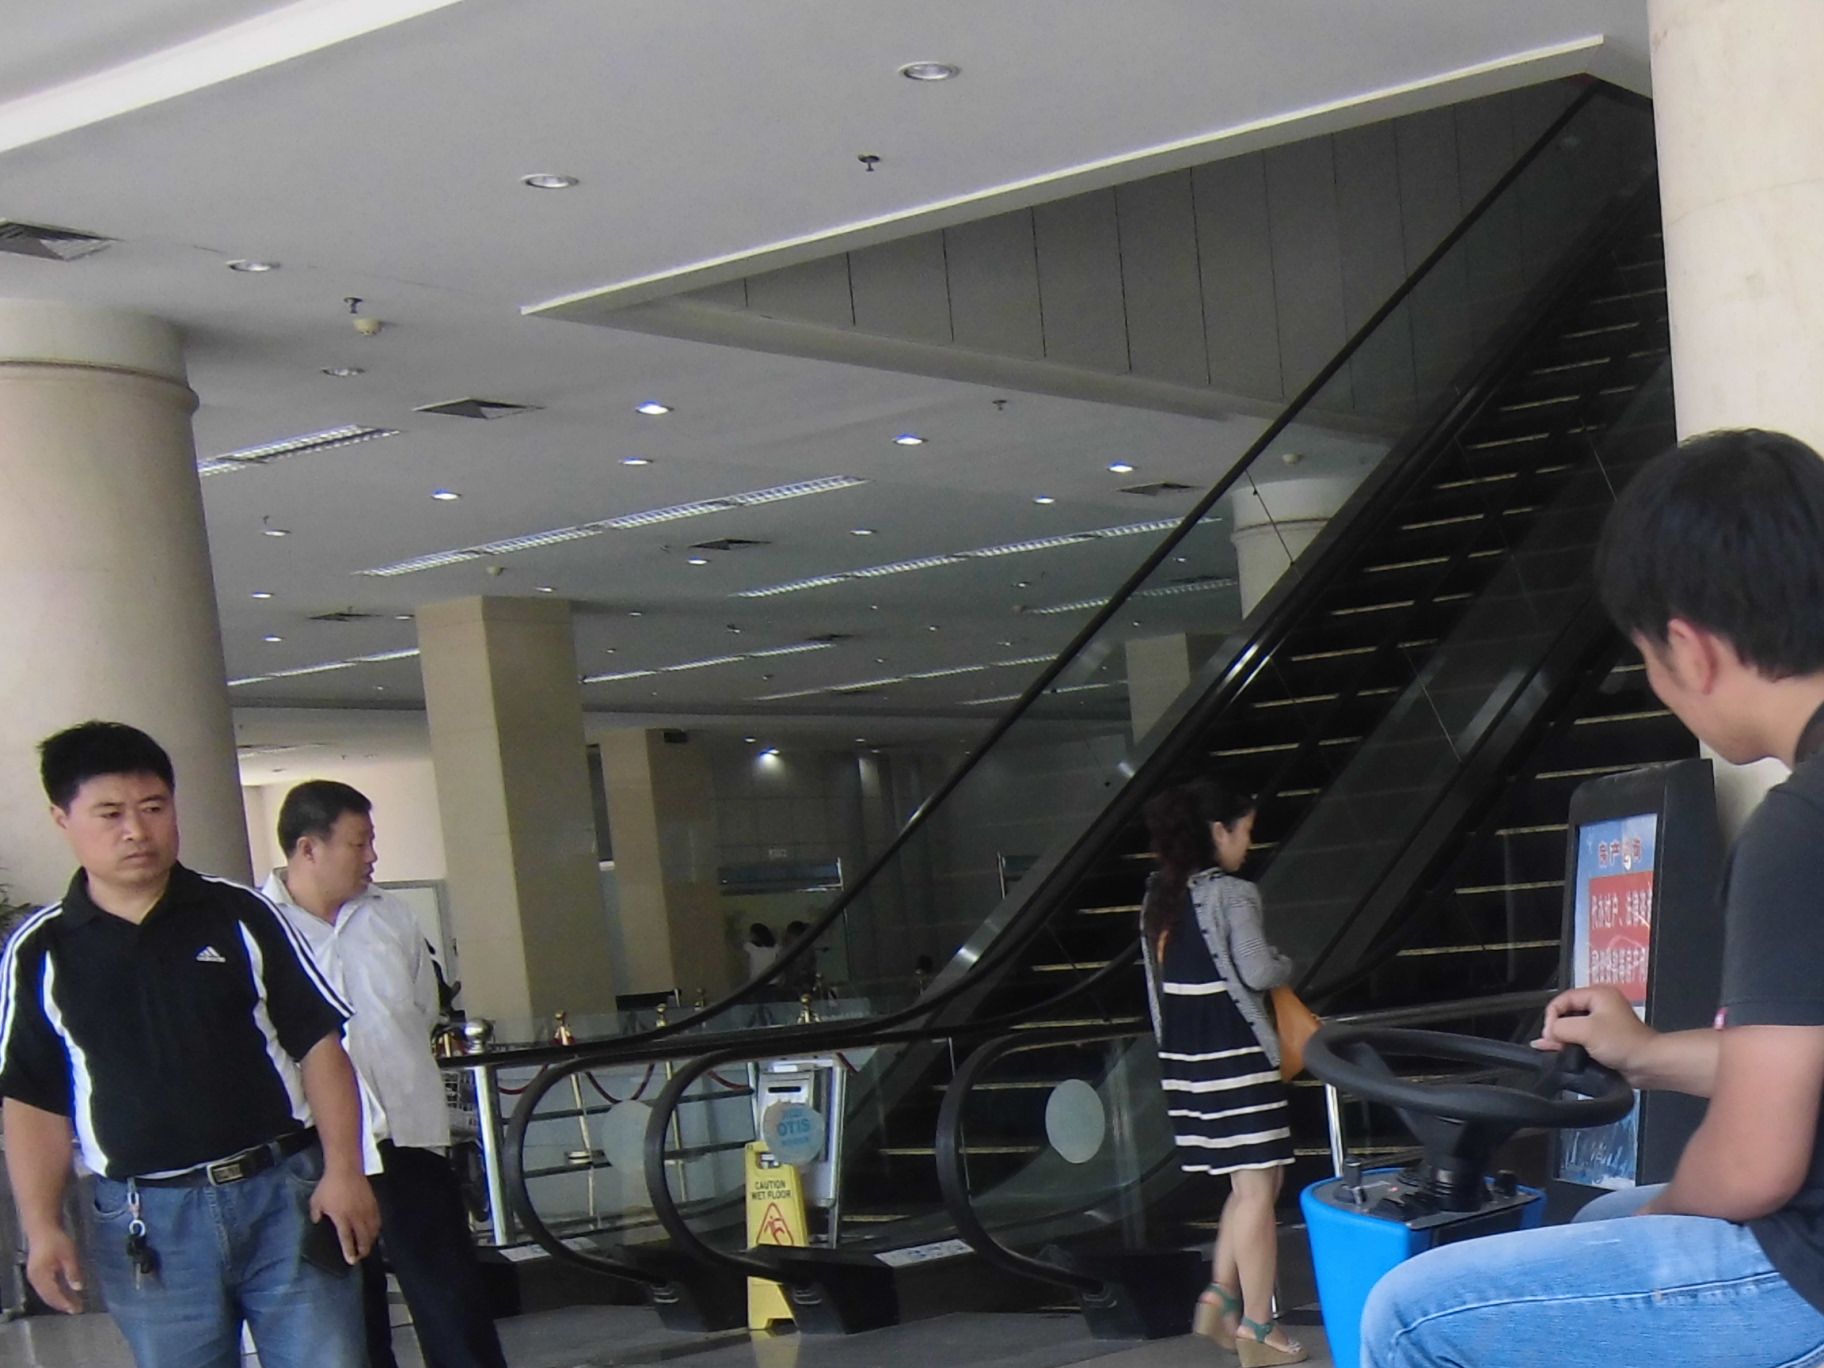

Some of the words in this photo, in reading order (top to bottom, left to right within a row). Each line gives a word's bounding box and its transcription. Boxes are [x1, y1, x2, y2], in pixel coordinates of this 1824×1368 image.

[777, 1119, 810, 1136] OTIS
[755, 1180, 786, 1190] CAUTION
[751, 1191, 767, 1200] WET
[768, 1189, 791, 1199] FLOOR
